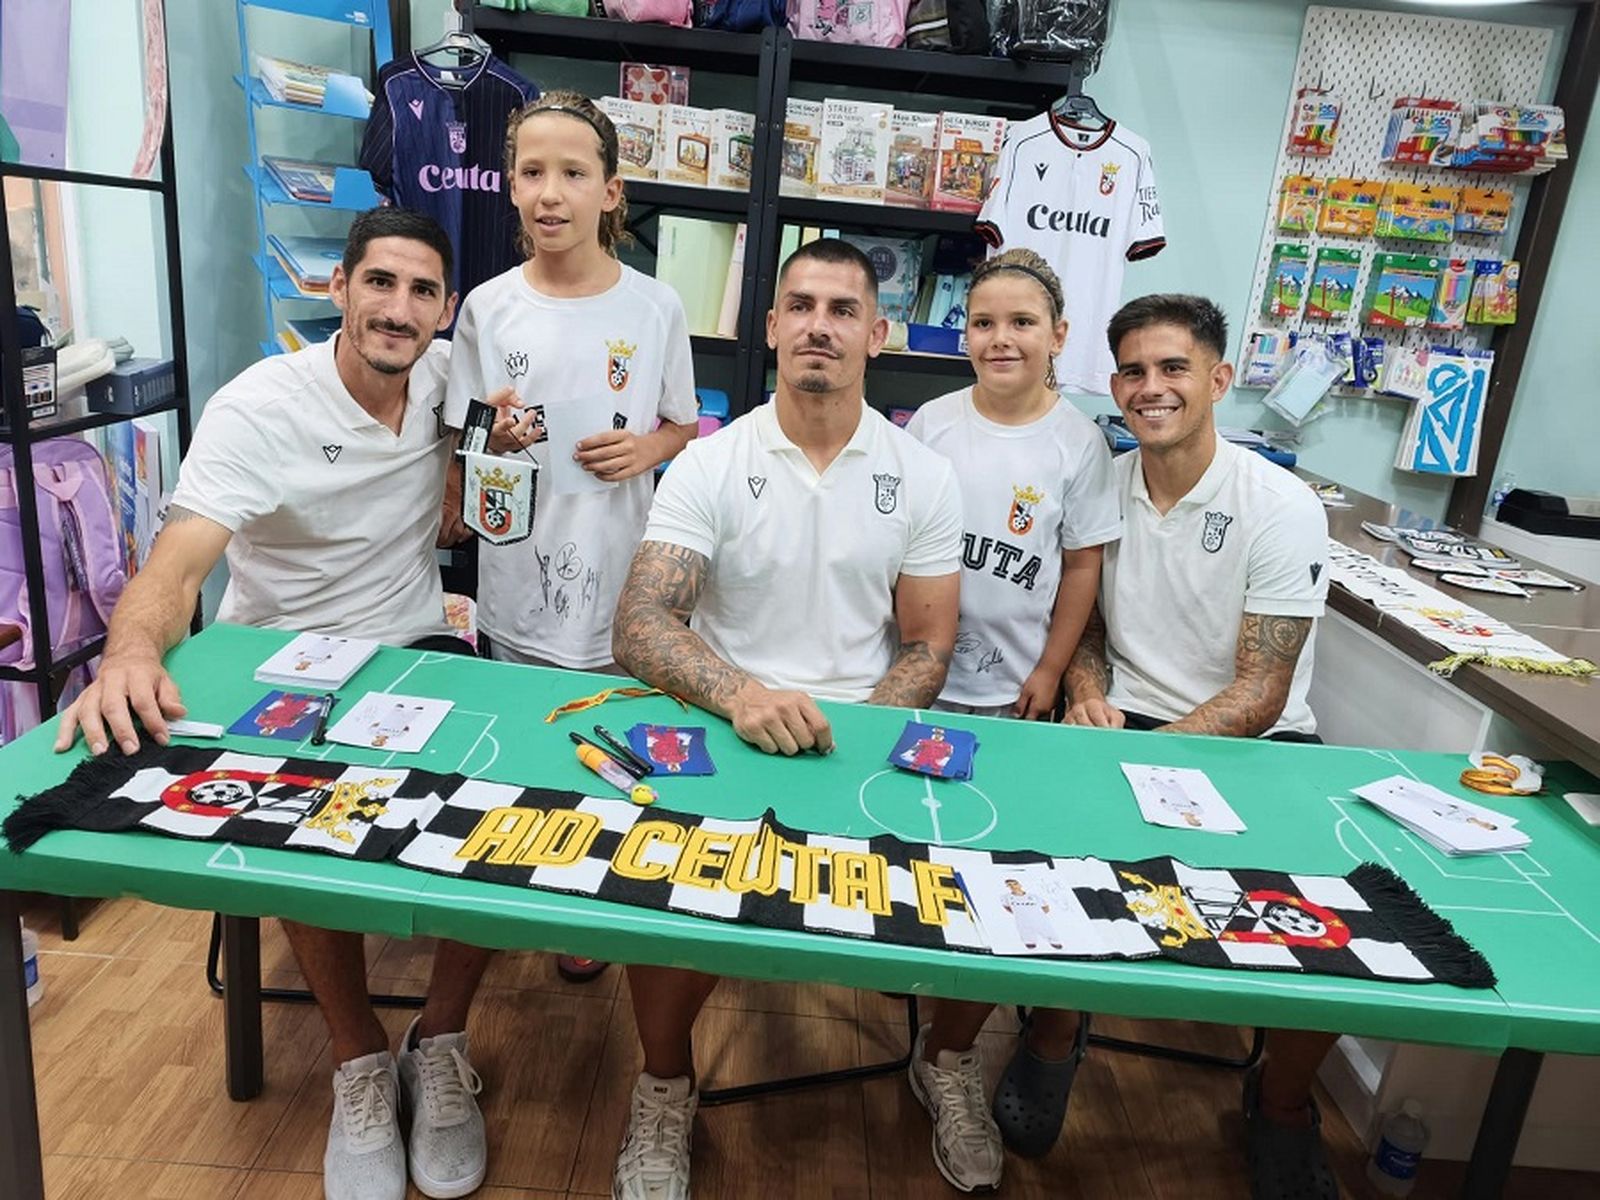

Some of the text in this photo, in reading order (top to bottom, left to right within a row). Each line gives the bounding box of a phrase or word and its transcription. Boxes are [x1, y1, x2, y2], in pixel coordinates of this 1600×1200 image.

[827, 104, 858, 112] STREET
[418, 163, 500, 192] Ceuta
[1026, 203, 1111, 238] Ceuta
[961, 532, 1042, 591] UTA
[453, 806, 975, 927] AD CEUTA F
